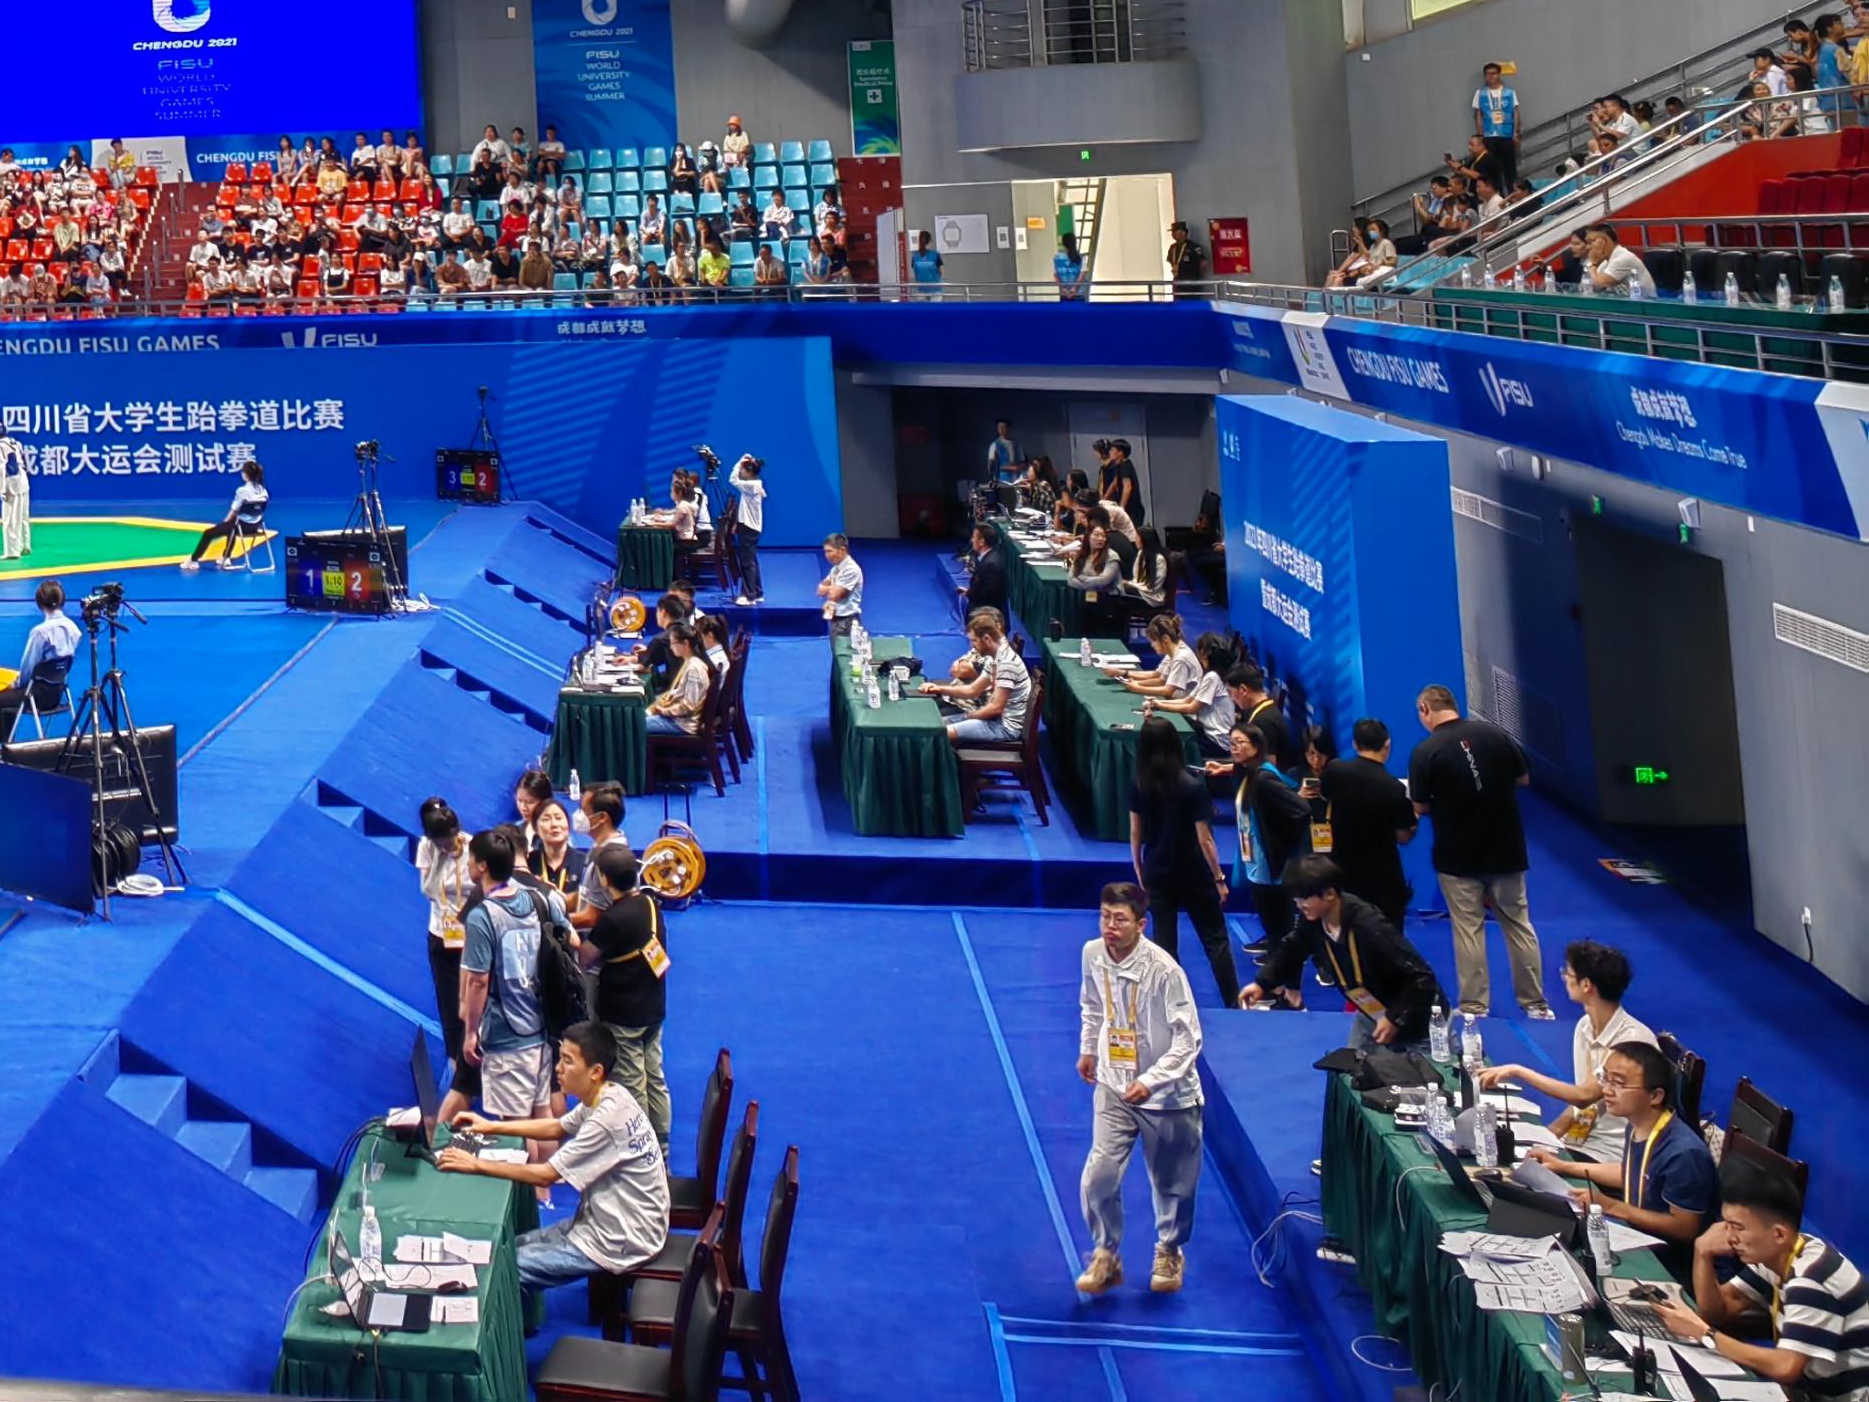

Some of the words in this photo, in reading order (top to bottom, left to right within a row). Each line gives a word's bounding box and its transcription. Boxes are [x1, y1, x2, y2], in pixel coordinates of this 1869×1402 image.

[570, 28, 613, 38] CHENGDU
[615, 27, 634, 36] 2021
[132, 39, 204, 51] CHENGDU
[207, 37, 238, 48] 2021
[585, 50, 620, 59] FISU
[157, 58, 214, 71] FISU
[586, 61, 621, 70] WORLD
[577, 71, 630, 81] UNIVERSITY
[588, 81, 621, 91] GAMES
[196, 151, 255, 164] CHENGDU
[79, 337, 128, 354] FISU
[137, 334, 220, 352] GAMES
[321, 333, 378, 348] FISU
[1499, 378, 1534, 408] FISU
[449, 470, 457, 484] 3
[478, 472, 487, 487] 2
[306, 568, 314, 589] 1
[351, 571, 362, 591] 2
